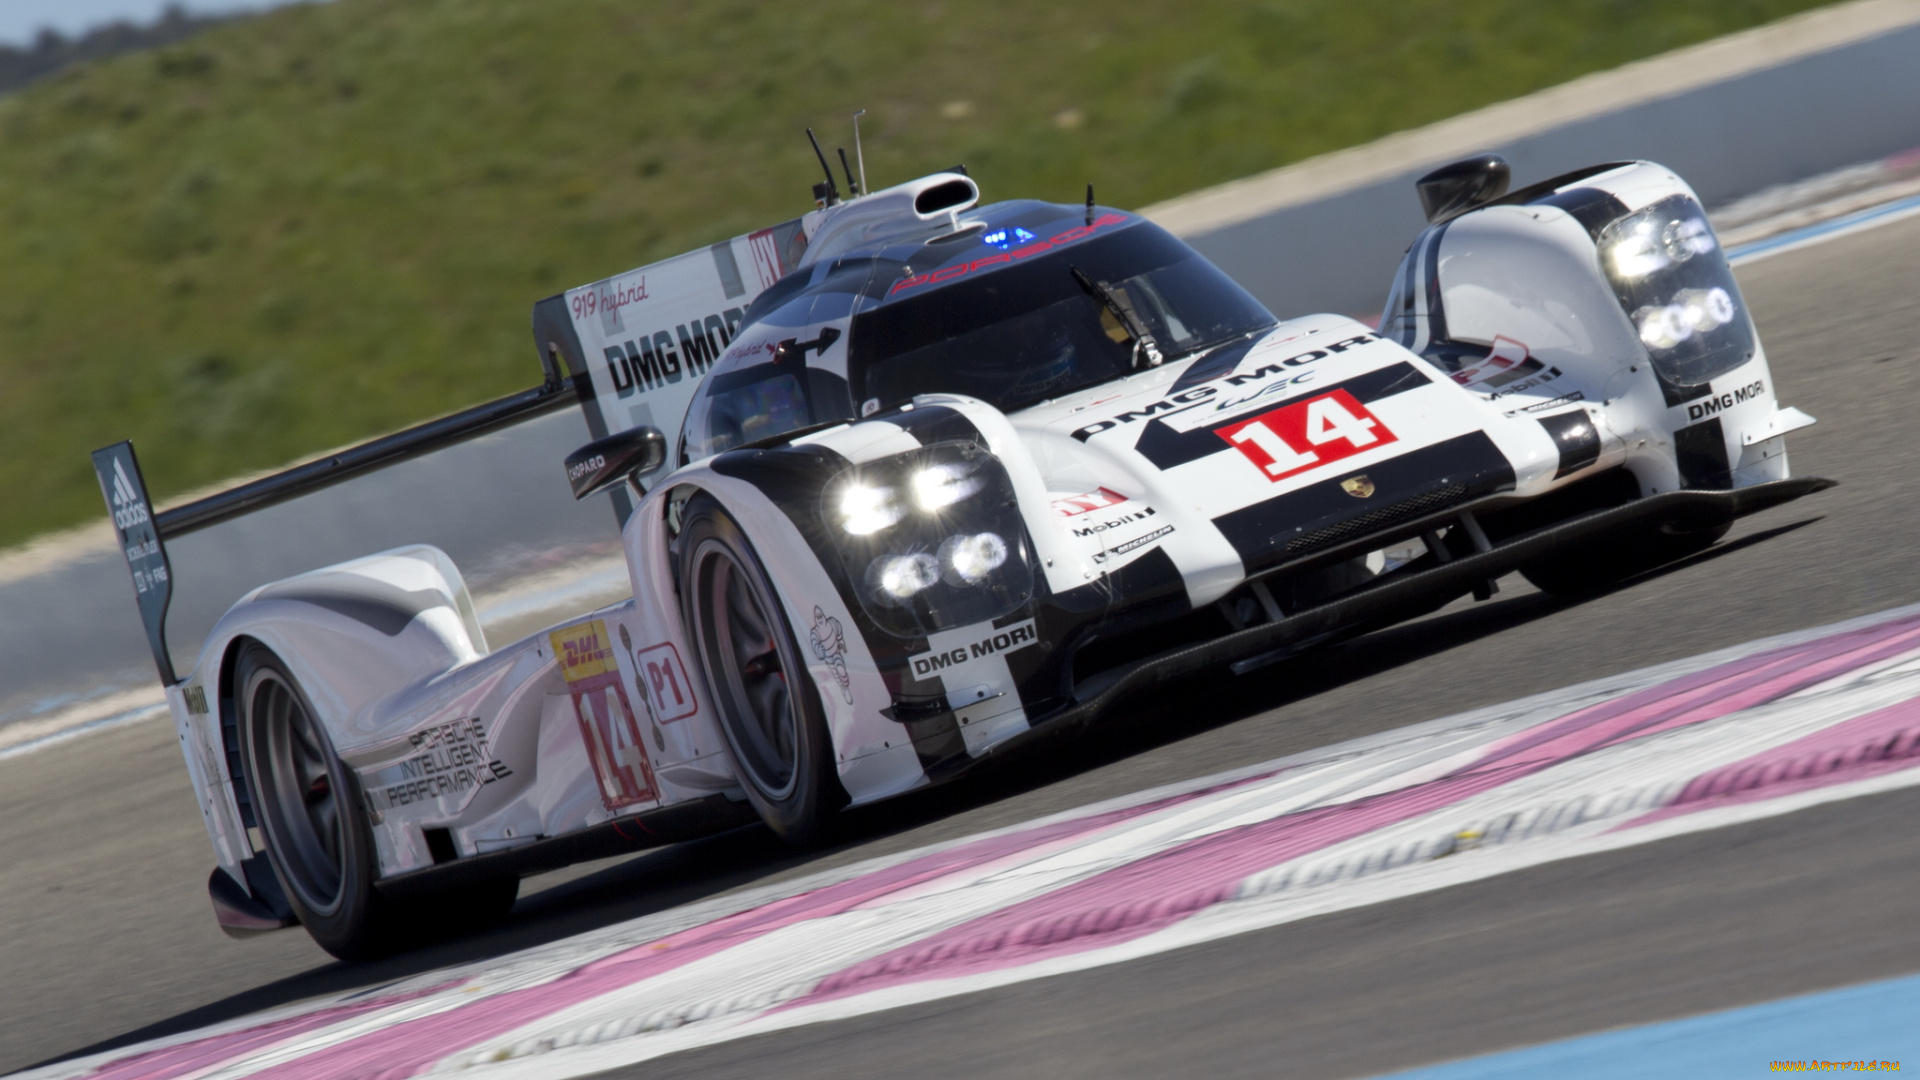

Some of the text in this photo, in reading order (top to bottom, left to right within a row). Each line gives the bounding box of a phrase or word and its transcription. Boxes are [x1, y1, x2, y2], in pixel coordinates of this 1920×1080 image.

[890, 213, 1128, 294] PORSCHE
[572, 275, 649, 326] 919 hybrid
[604, 329, 683, 400] DMG
[1070, 387, 1218, 444] DMG
[1688, 379, 1765, 420] DMG MORI
[1230, 396, 1379, 477] 14
[568, 454, 606, 481] CHOPARD
[115, 500, 148, 530] adidas
[1072, 515, 1134, 537] Mobil
[562, 633, 605, 668] DHL
[913, 624, 1037, 676] DMG MORI
[646, 657, 684, 711] P1
[408, 717, 486, 751] PORSCHE
[580, 684, 648, 800] 14
[387, 760, 514, 807] PERFORMANCE
[400, 740, 492, 780] INTELLIGENT
